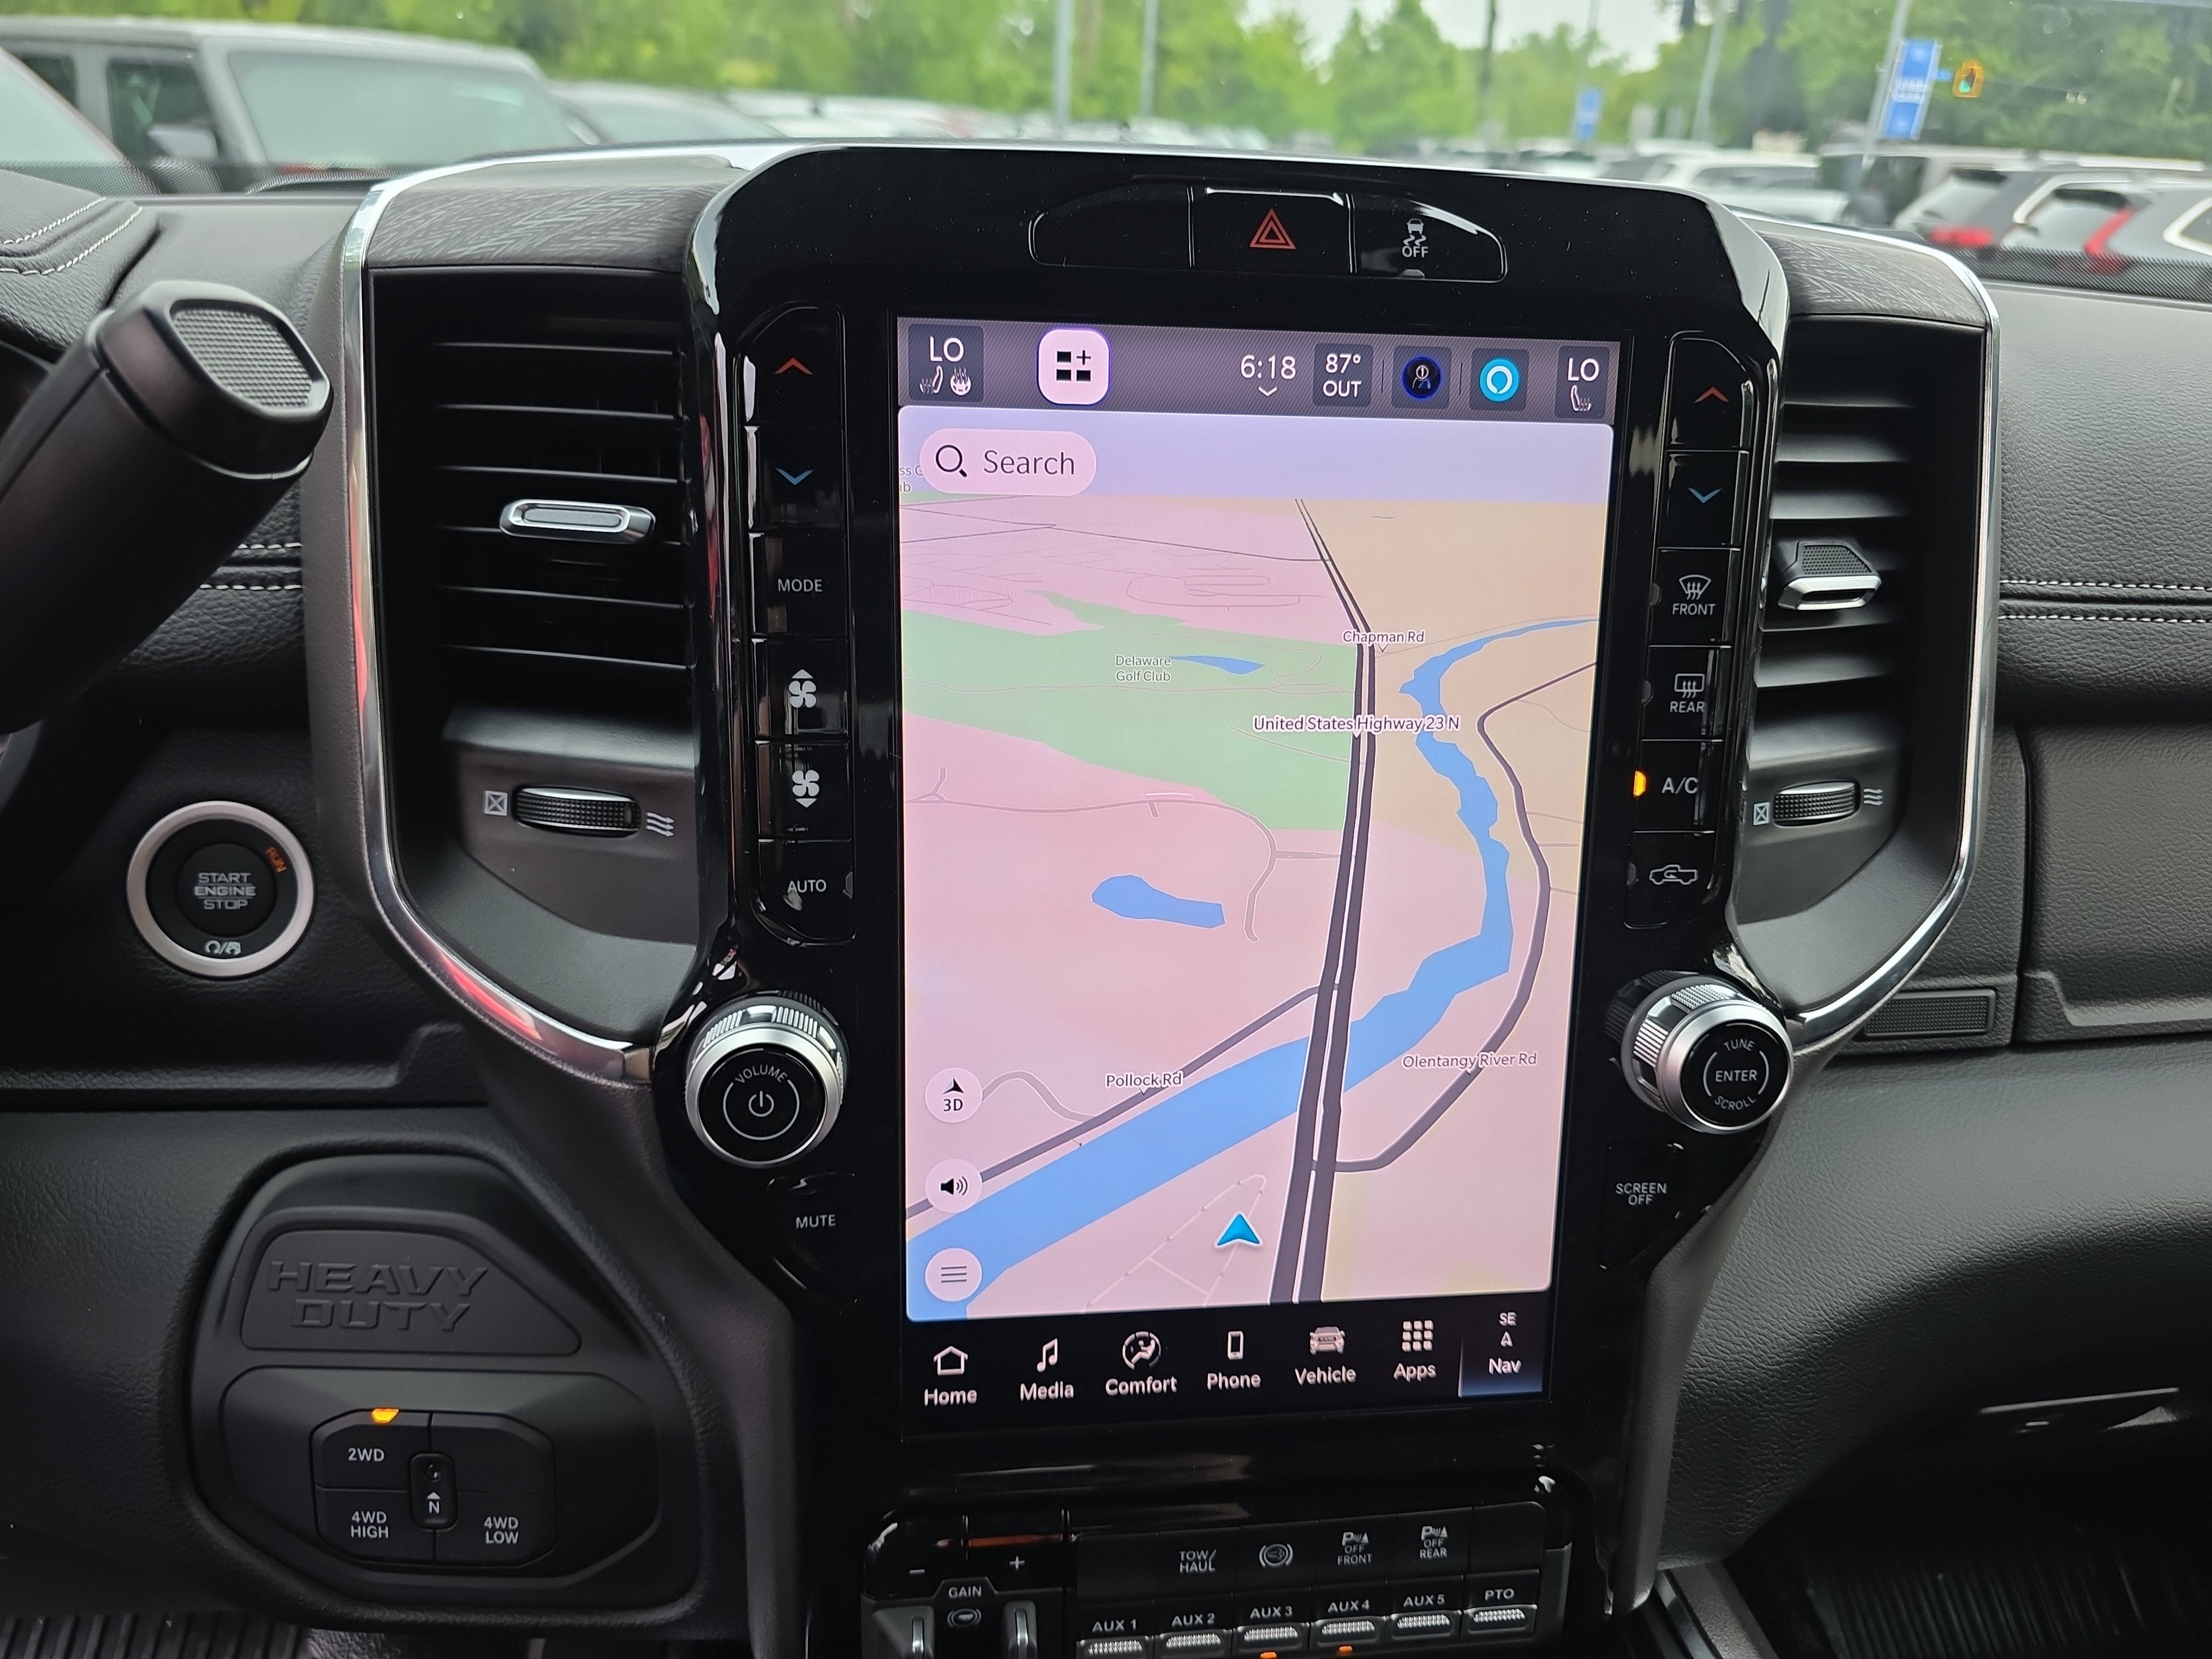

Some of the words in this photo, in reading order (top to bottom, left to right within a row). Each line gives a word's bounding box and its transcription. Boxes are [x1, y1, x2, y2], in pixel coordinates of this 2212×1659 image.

[1402, 246, 1429, 258] OFF
[929, 336, 964, 362] LO
[1240, 354, 1296, 380] 6:18
[1325, 353, 1361, 374] 87°
[1567, 357, 1599, 382] LO
[1323, 380, 1361, 398] OUT
[983, 449, 1075, 475] Search
[778, 578, 823, 593] MODE
[1673, 603, 1716, 616] FRONT
[1343, 630, 1404, 646] Chapman
[1408, 631, 1424, 644] Rd
[1115, 655, 1172, 667] Delaware
[1116, 670, 1142, 682] Golf
[1144, 671, 1172, 682] Club
[1670, 701, 1705, 713] REAR
[1253, 717, 1304, 731] United
[1308, 717, 1354, 731] States
[1358, 717, 1423, 734] Highway
[1426, 718, 1444, 730] 23
[1448, 717, 1459, 730] N
[1662, 776, 1699, 795] A/C
[198, 872, 252, 883] START
[194, 886, 256, 896] ENGINE
[787, 879, 827, 893] AUTO
[204, 899, 248, 910] STOP
[1724, 1038, 1756, 1051] TUNE
[1403, 1053, 1476, 1069] Olentangy
[1480, 1053, 1515, 1066] River
[1519, 1052, 1536, 1065] Rd
[735, 1064, 788, 1084] VOLUME
[1107, 1073, 1159, 1086] Pollock
[1163, 1072, 1182, 1085] Rd
[1715, 1069, 1757, 1083] ENTER
[943, 1098, 963, 1112] 3D
[1714, 1095, 1757, 1111] SCROLL
[1615, 1182, 1667, 1195] SCREEN
[1628, 1194, 1654, 1206] OFF
[795, 1214, 837, 1229] MUTE
[268, 1261, 488, 1297] HEAVY
[292, 1298, 470, 1331] DUTY
[1499, 1311, 1517, 1326] SE
[1393, 1362, 1437, 1381] Apps
[1488, 1358, 1522, 1375] Nav
[1207, 1371, 1262, 1391] Phone
[1295, 1365, 1357, 1386] Vehicle
[1020, 1380, 1075, 1401] Media
[1105, 1375, 1177, 1396] Comfort
[924, 1387, 977, 1406] Home
[348, 1447, 385, 1462] 2WD
[429, 1500, 440, 1514] N
[351, 1510, 387, 1525] 4WD
[484, 1516, 519, 1530] 4WD
[350, 1525, 389, 1539] HIGH
[486, 1531, 519, 1545] LOW
[1345, 1545, 1365, 1554] OFF
[1424, 1538, 1444, 1548] OFF
[1179, 1548, 1217, 1562] TOW/
[1337, 1553, 1373, 1566] FRONT
[1419, 1547, 1448, 1560] REAR
[1179, 1560, 1216, 1573] HAUL
[948, 1585, 982, 1599] GAIN
[1484, 1588, 1515, 1601] PTO
[1327, 1600, 1358, 1612] AUX
[1359, 1599, 1371, 1611] 4
[1403, 1595, 1434, 1607] AUX
[1436, 1593, 1445, 1605] 5
[1249, 1606, 1281, 1619] AUX
[1283, 1605, 1293, 1617] 3
[1091, 1620, 1127, 1633] AUX
[1131, 1619, 1137, 1631] 1
[1171, 1614, 1203, 1627] AUX
[1205, 1612, 1216, 1625] 2
